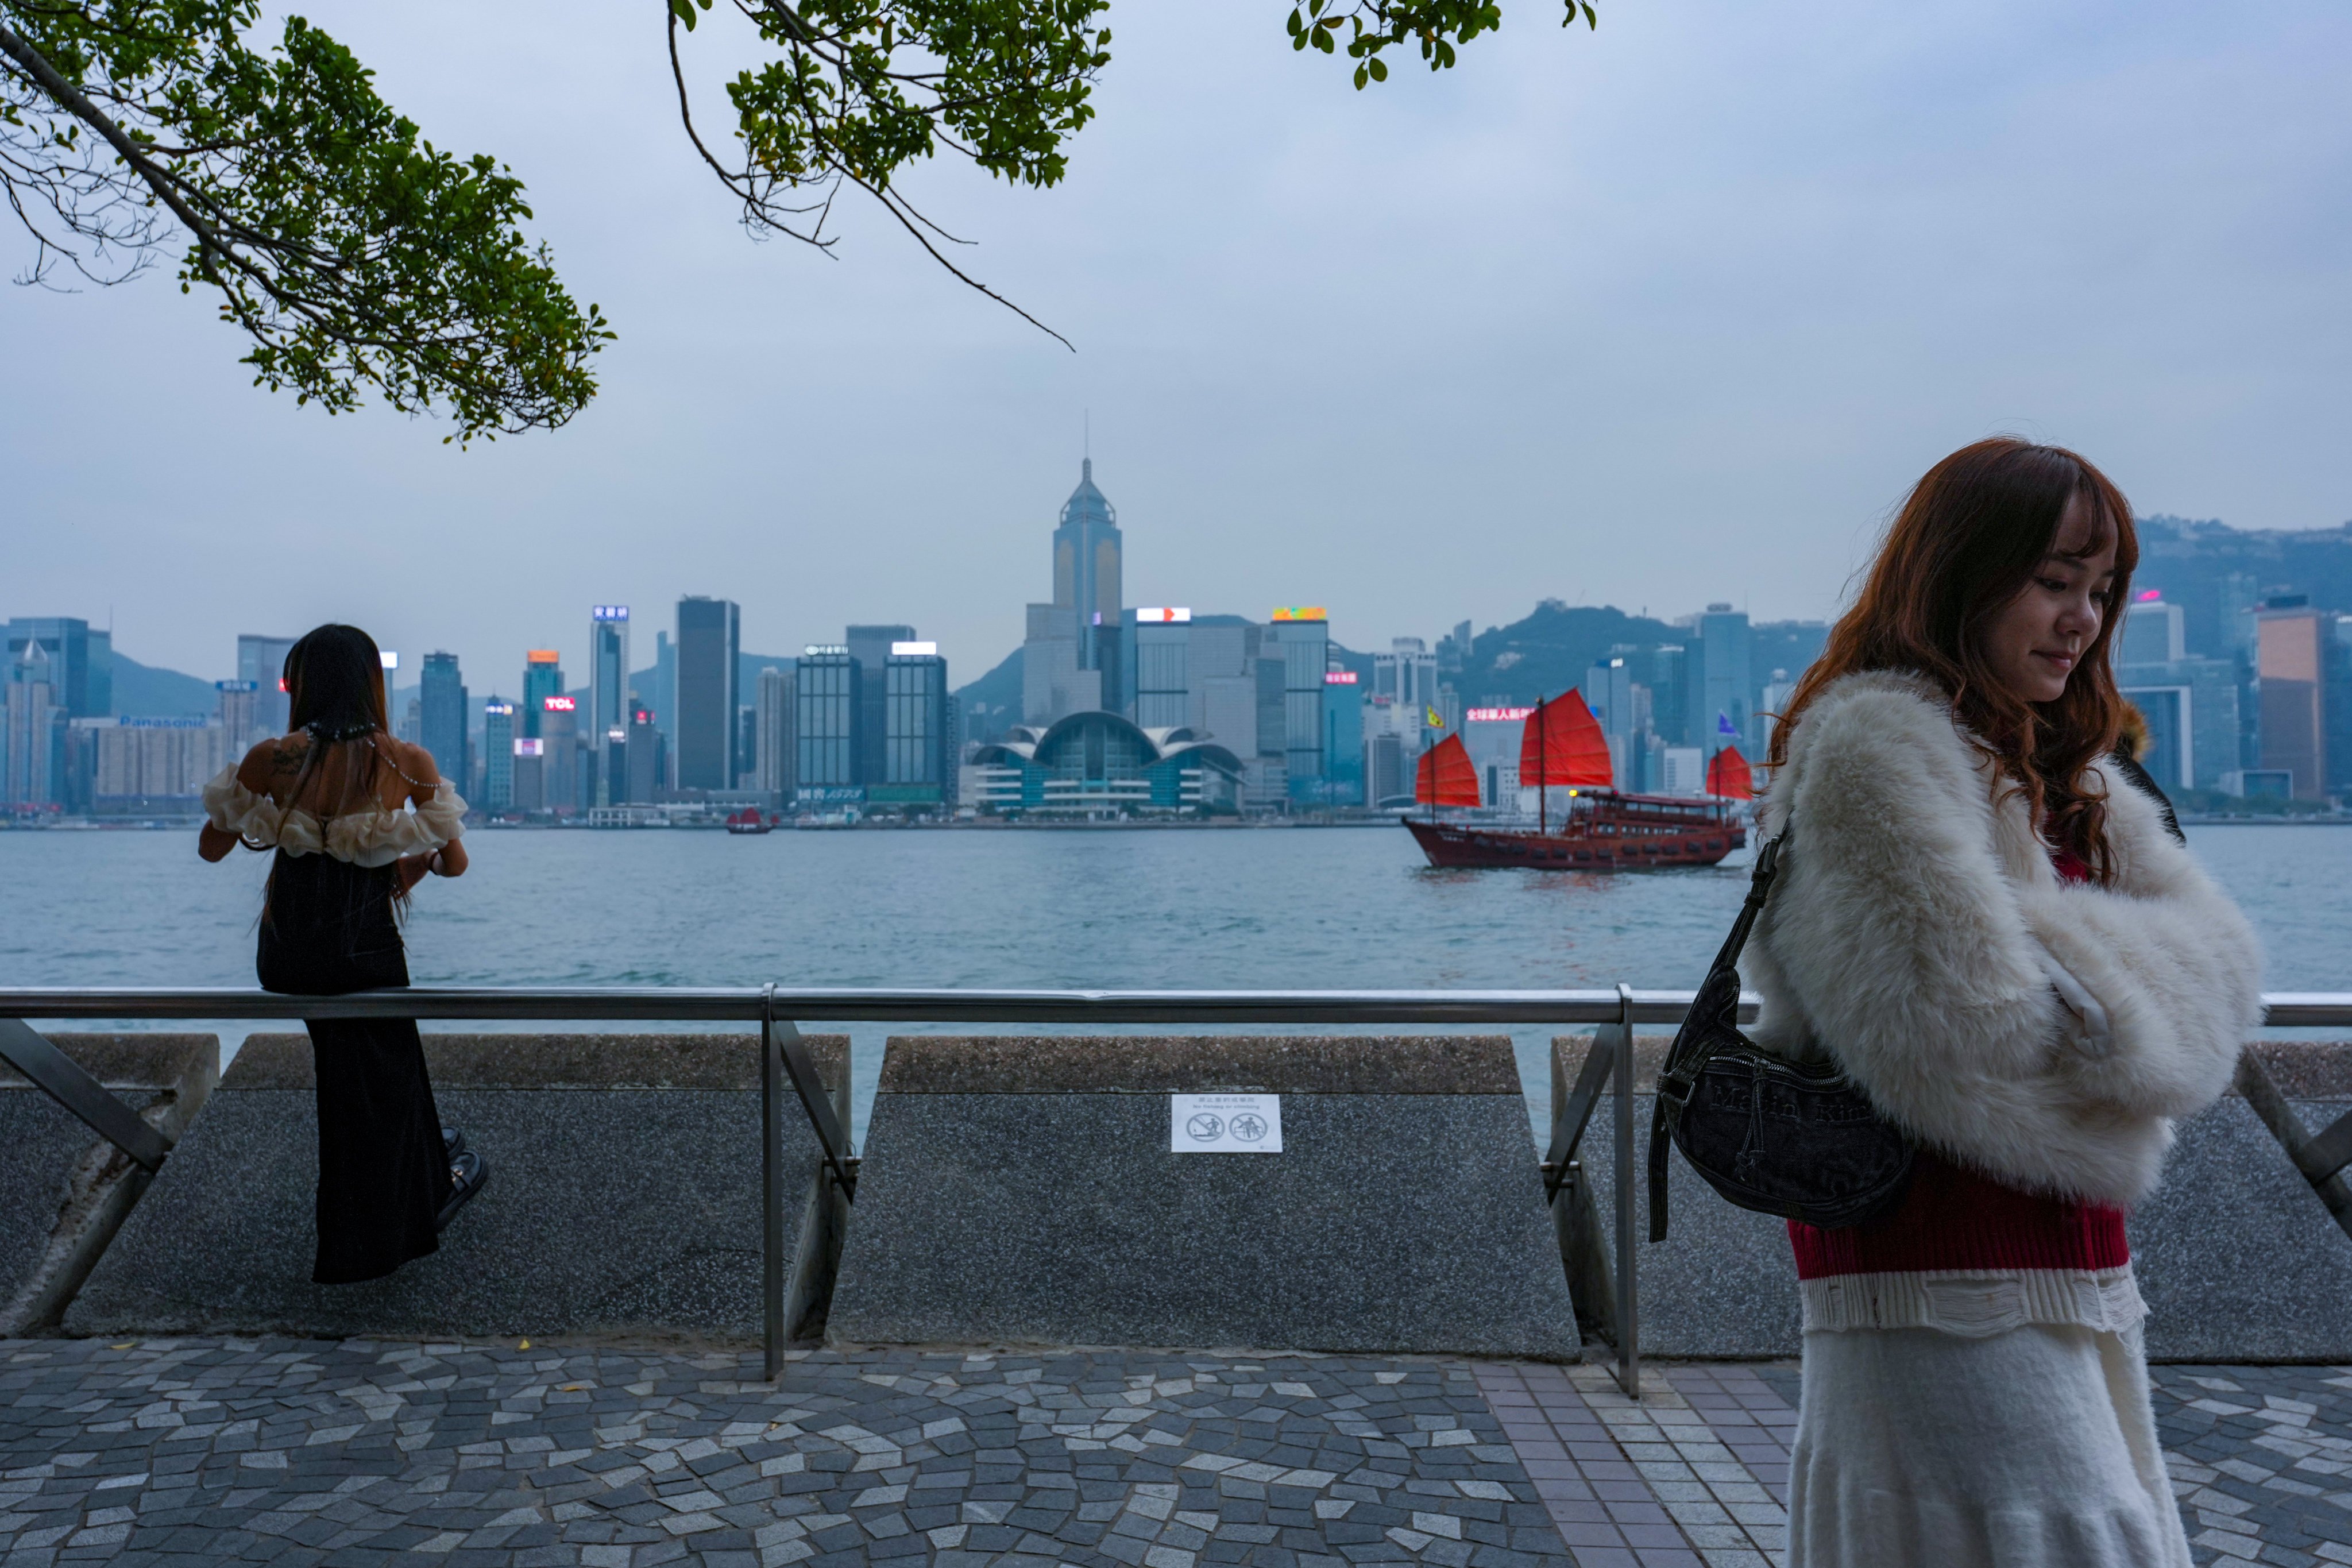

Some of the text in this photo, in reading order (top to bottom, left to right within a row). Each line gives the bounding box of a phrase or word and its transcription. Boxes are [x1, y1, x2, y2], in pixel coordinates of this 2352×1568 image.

[545, 698, 574, 709] TCL
[1466, 707, 1535, 721] 全球華人新年
[119, 715, 207, 728] Panasonic
[1816, 1103, 1871, 1122] Kim
